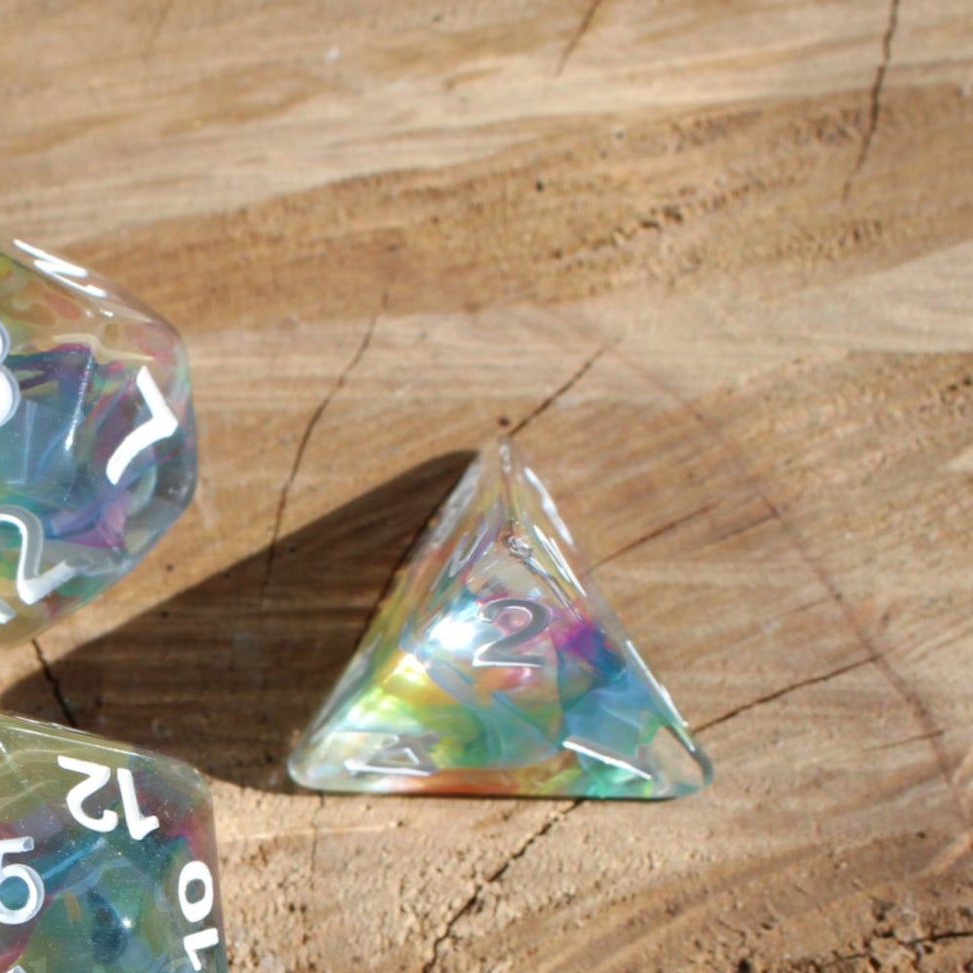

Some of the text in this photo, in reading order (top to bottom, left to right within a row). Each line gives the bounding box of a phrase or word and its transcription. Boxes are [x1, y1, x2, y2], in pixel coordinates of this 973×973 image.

[106, 365, 179, 486] 7
[472, 598, 551, 668] 2
[57, 756, 160, 840] 12
[178, 861, 219, 971] 10
